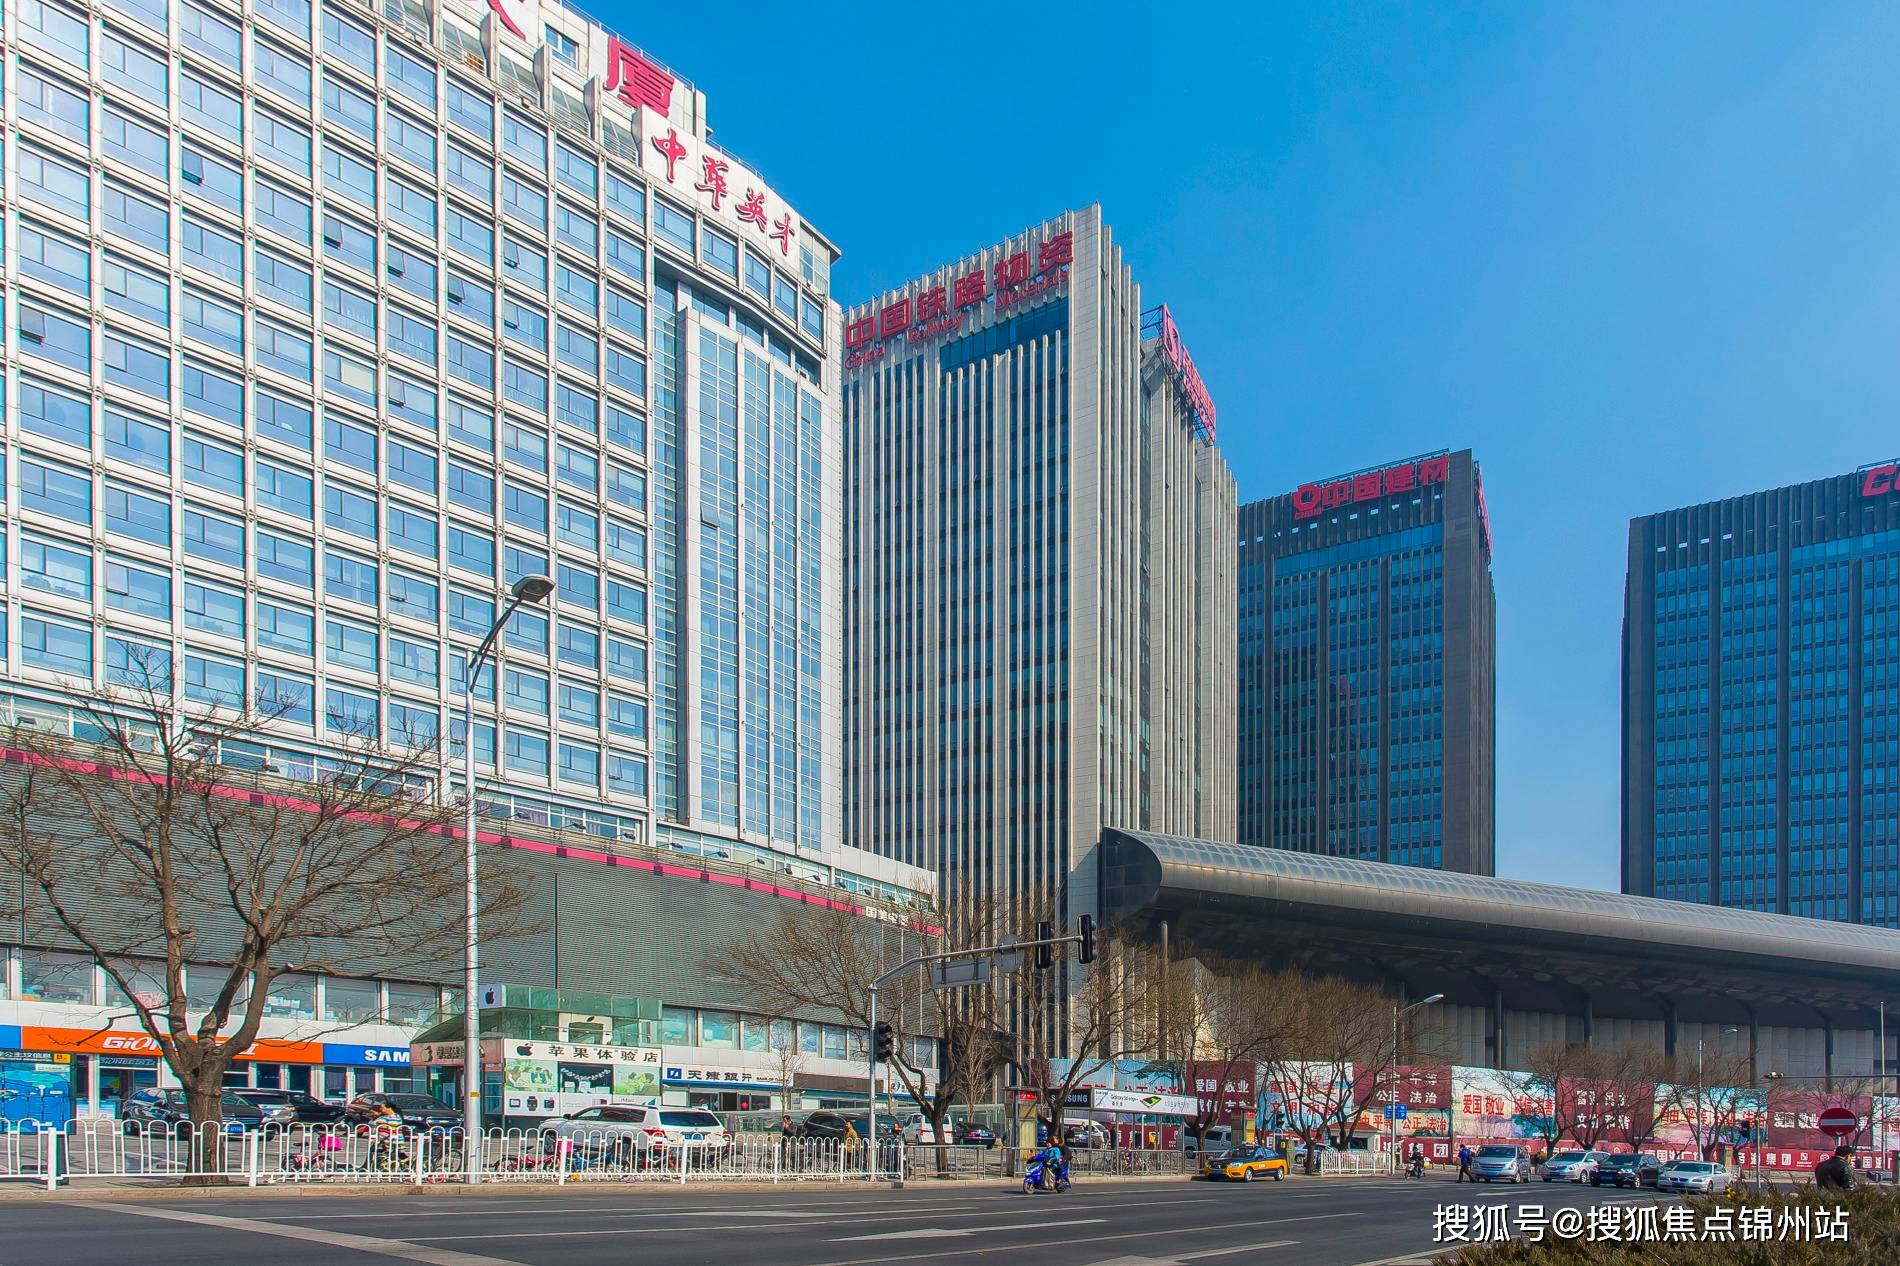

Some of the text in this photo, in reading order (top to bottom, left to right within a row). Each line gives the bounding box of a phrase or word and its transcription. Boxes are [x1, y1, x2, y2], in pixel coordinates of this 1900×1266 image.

[845, 230, 1074, 349] 中国铁路物资
[1322, 454, 1450, 508] 中国建材
[548, 1045, 659, 1063] 苹果体验店
[1195, 1079, 1217, 1093] 爱国
[1051, 1093, 1088, 1103] SSUNG
[1375, 1090, 1437, 1104] 公正 法治
[1463, 1094, 1482, 1114] 爱国
[1485, 1096, 1505, 1115] 敬业
[1402, 1117, 1422, 1130] 公正
[1426, 1118, 1447, 1131] 法治
